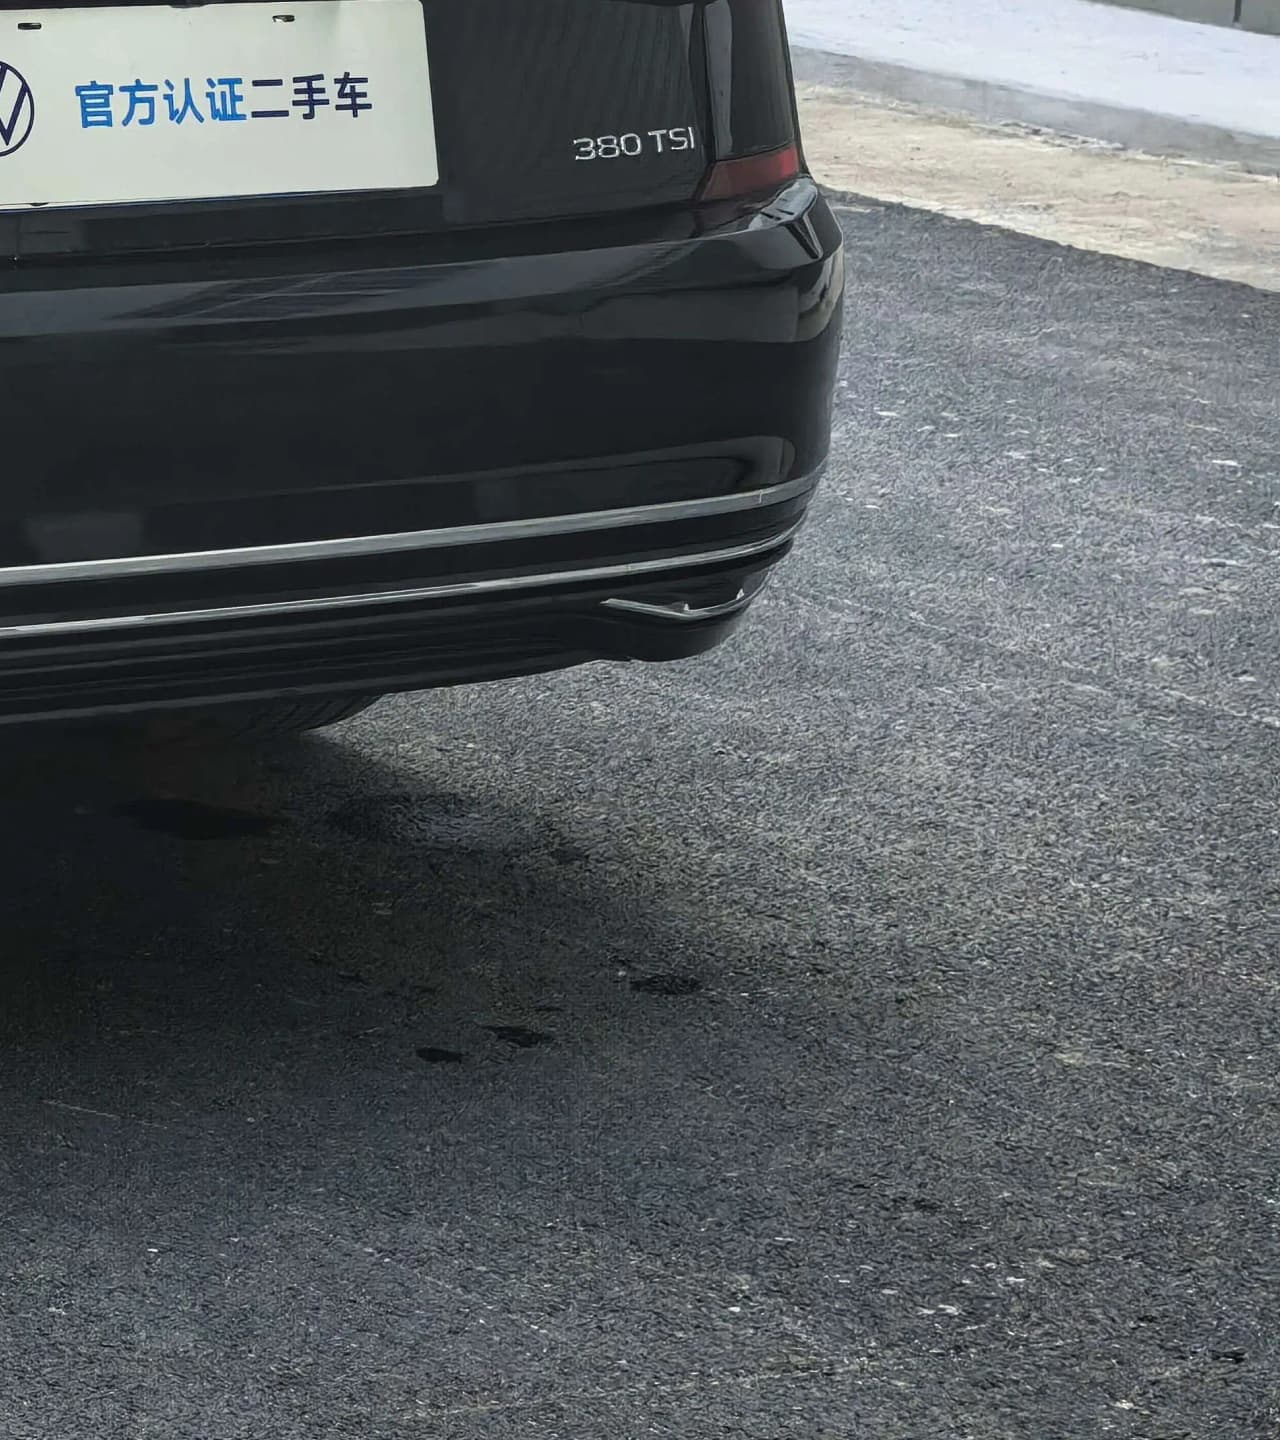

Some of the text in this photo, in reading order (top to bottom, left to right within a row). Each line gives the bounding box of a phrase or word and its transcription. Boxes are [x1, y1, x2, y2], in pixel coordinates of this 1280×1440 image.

[74, 71, 373, 129] 官方认证二手车
[573, 126, 695, 161] 380 TSI
